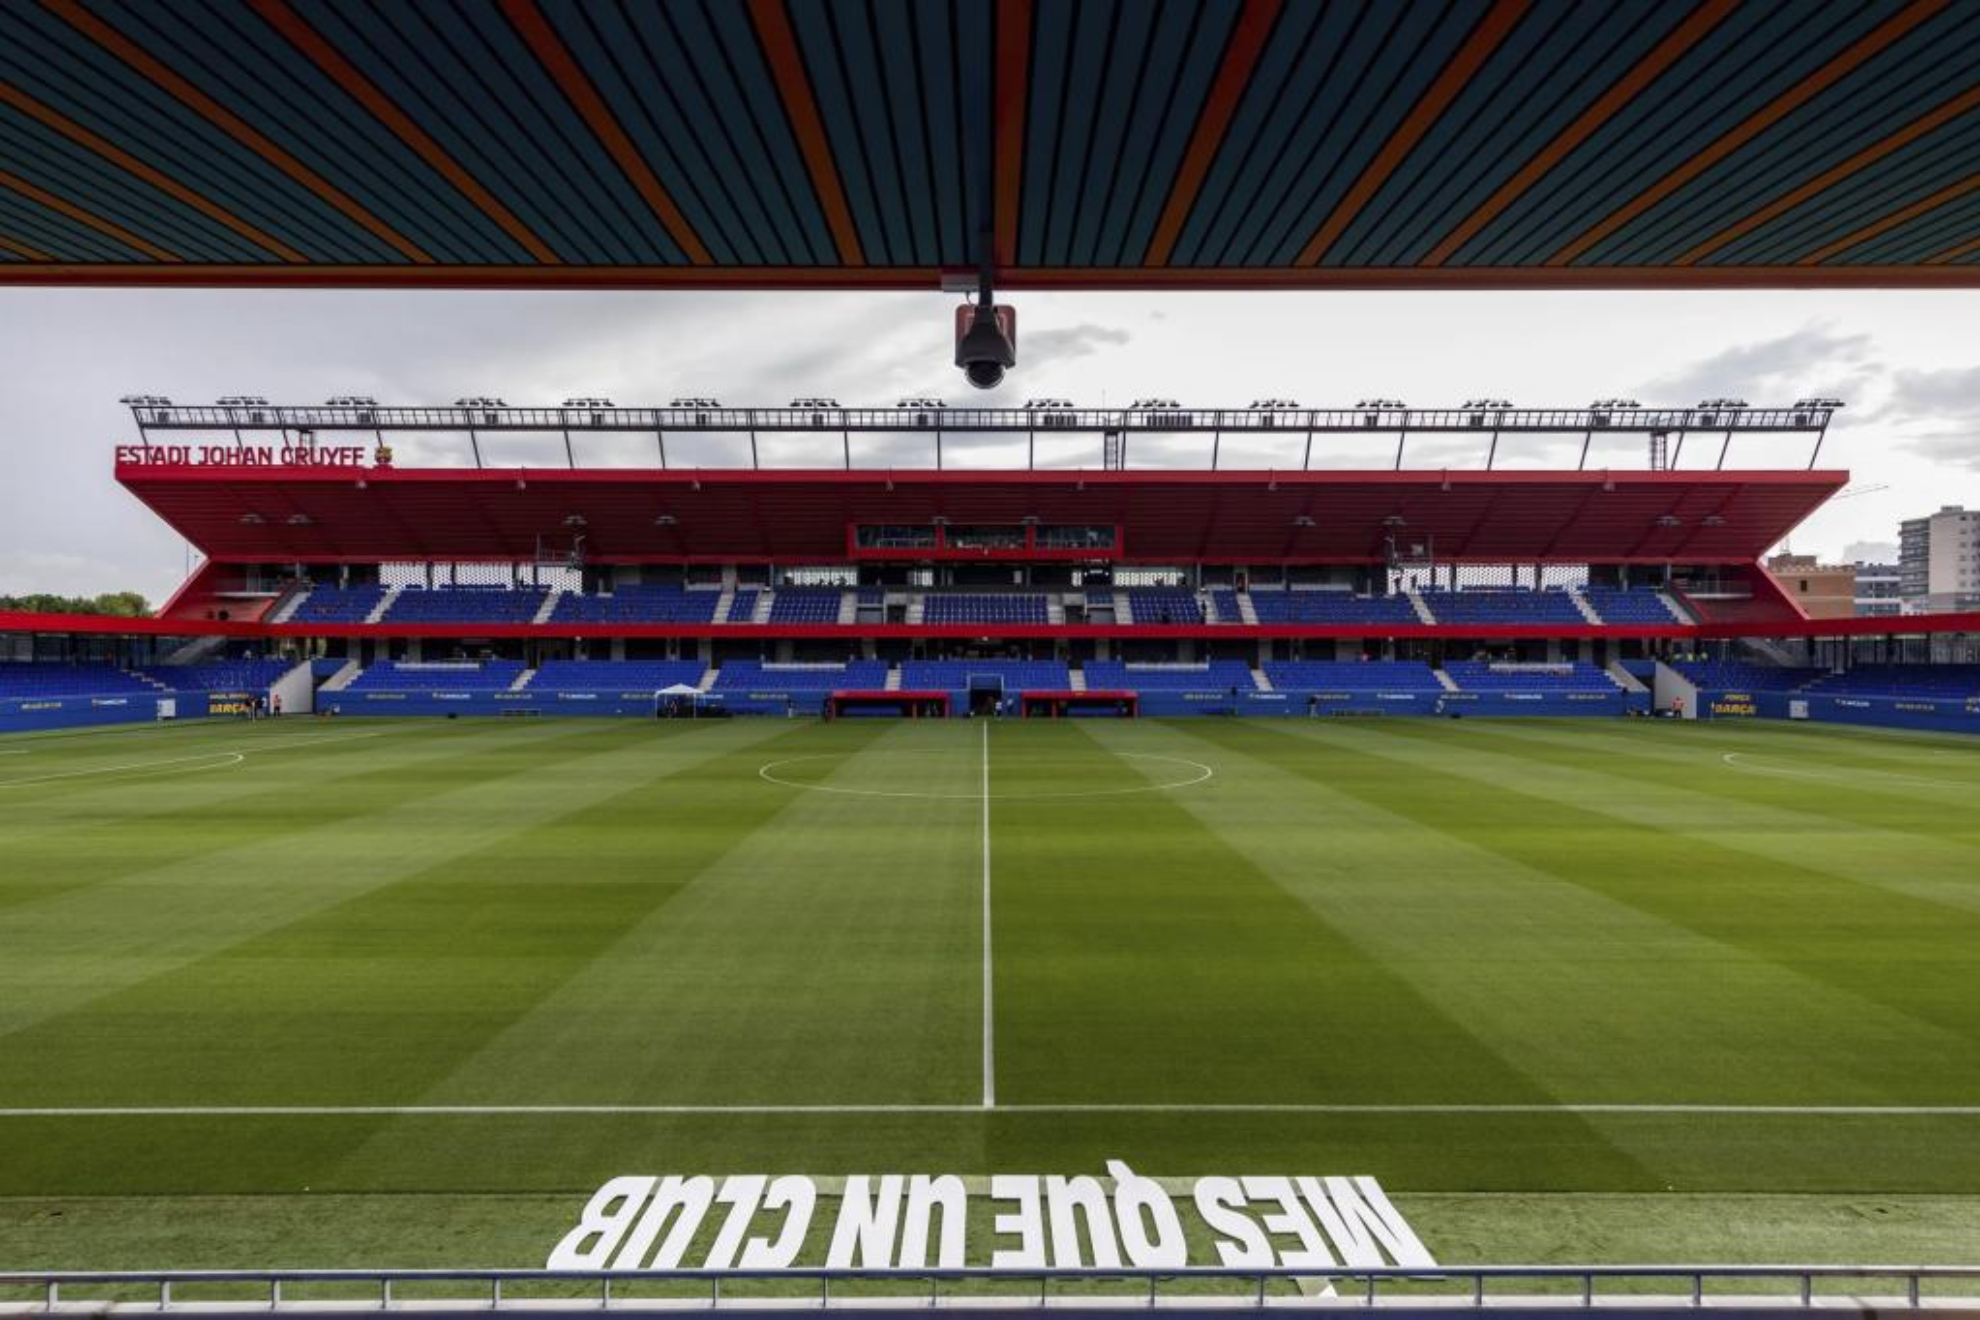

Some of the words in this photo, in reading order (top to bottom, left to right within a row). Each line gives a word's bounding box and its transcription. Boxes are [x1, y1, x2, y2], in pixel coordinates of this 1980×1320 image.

[115, 446, 192, 466] ESTADI
[198, 446, 273, 466] JOHAN
[281, 446, 365, 467] CRUYFF
[546, 1174, 817, 1273] CLUB
[825, 1174, 968, 1273] UN
[991, 1159, 1188, 1273] QUE
